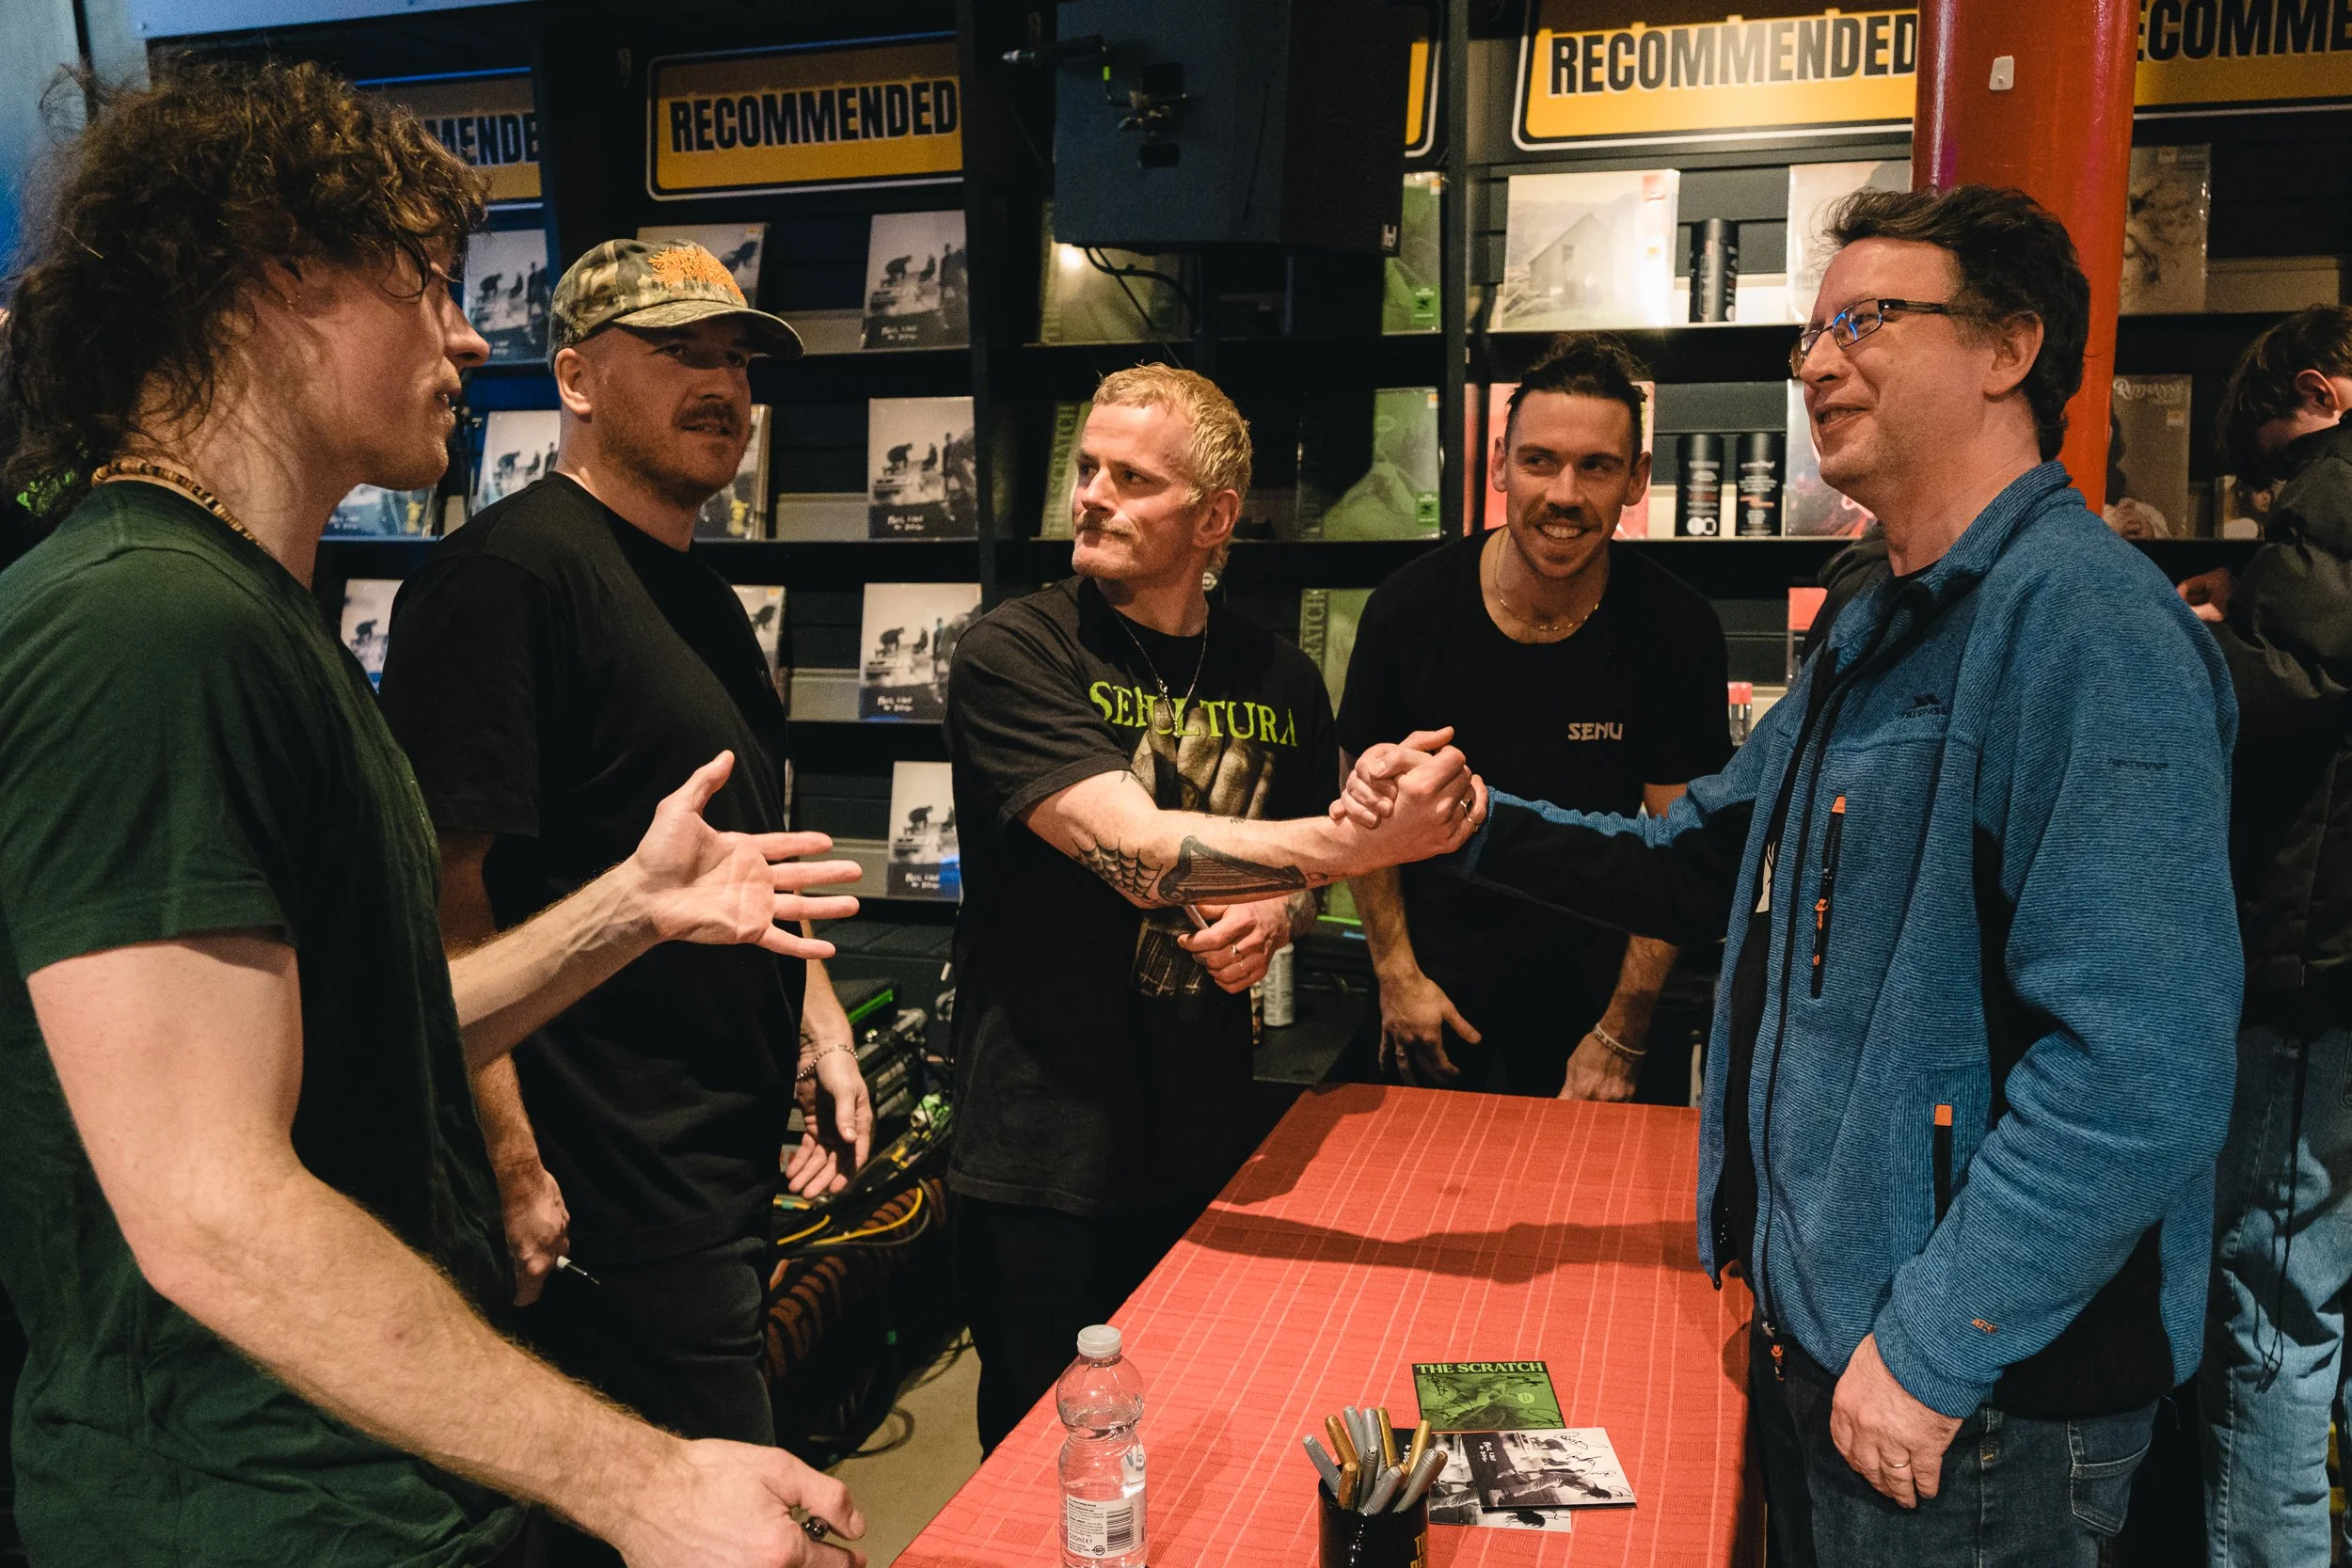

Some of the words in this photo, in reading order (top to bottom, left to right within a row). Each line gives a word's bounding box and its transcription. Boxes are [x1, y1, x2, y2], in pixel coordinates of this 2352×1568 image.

[1550, 13, 1917, 95] RECOMMENDED
[2137, 0, 2352, 60] COMME
[670, 80, 958, 152] RECOMMENDED
[1567, 721, 1624, 741] SENU
[1416, 1364, 1454, 1374] THE
[1458, 1362, 1544, 1373] SCRATCH
